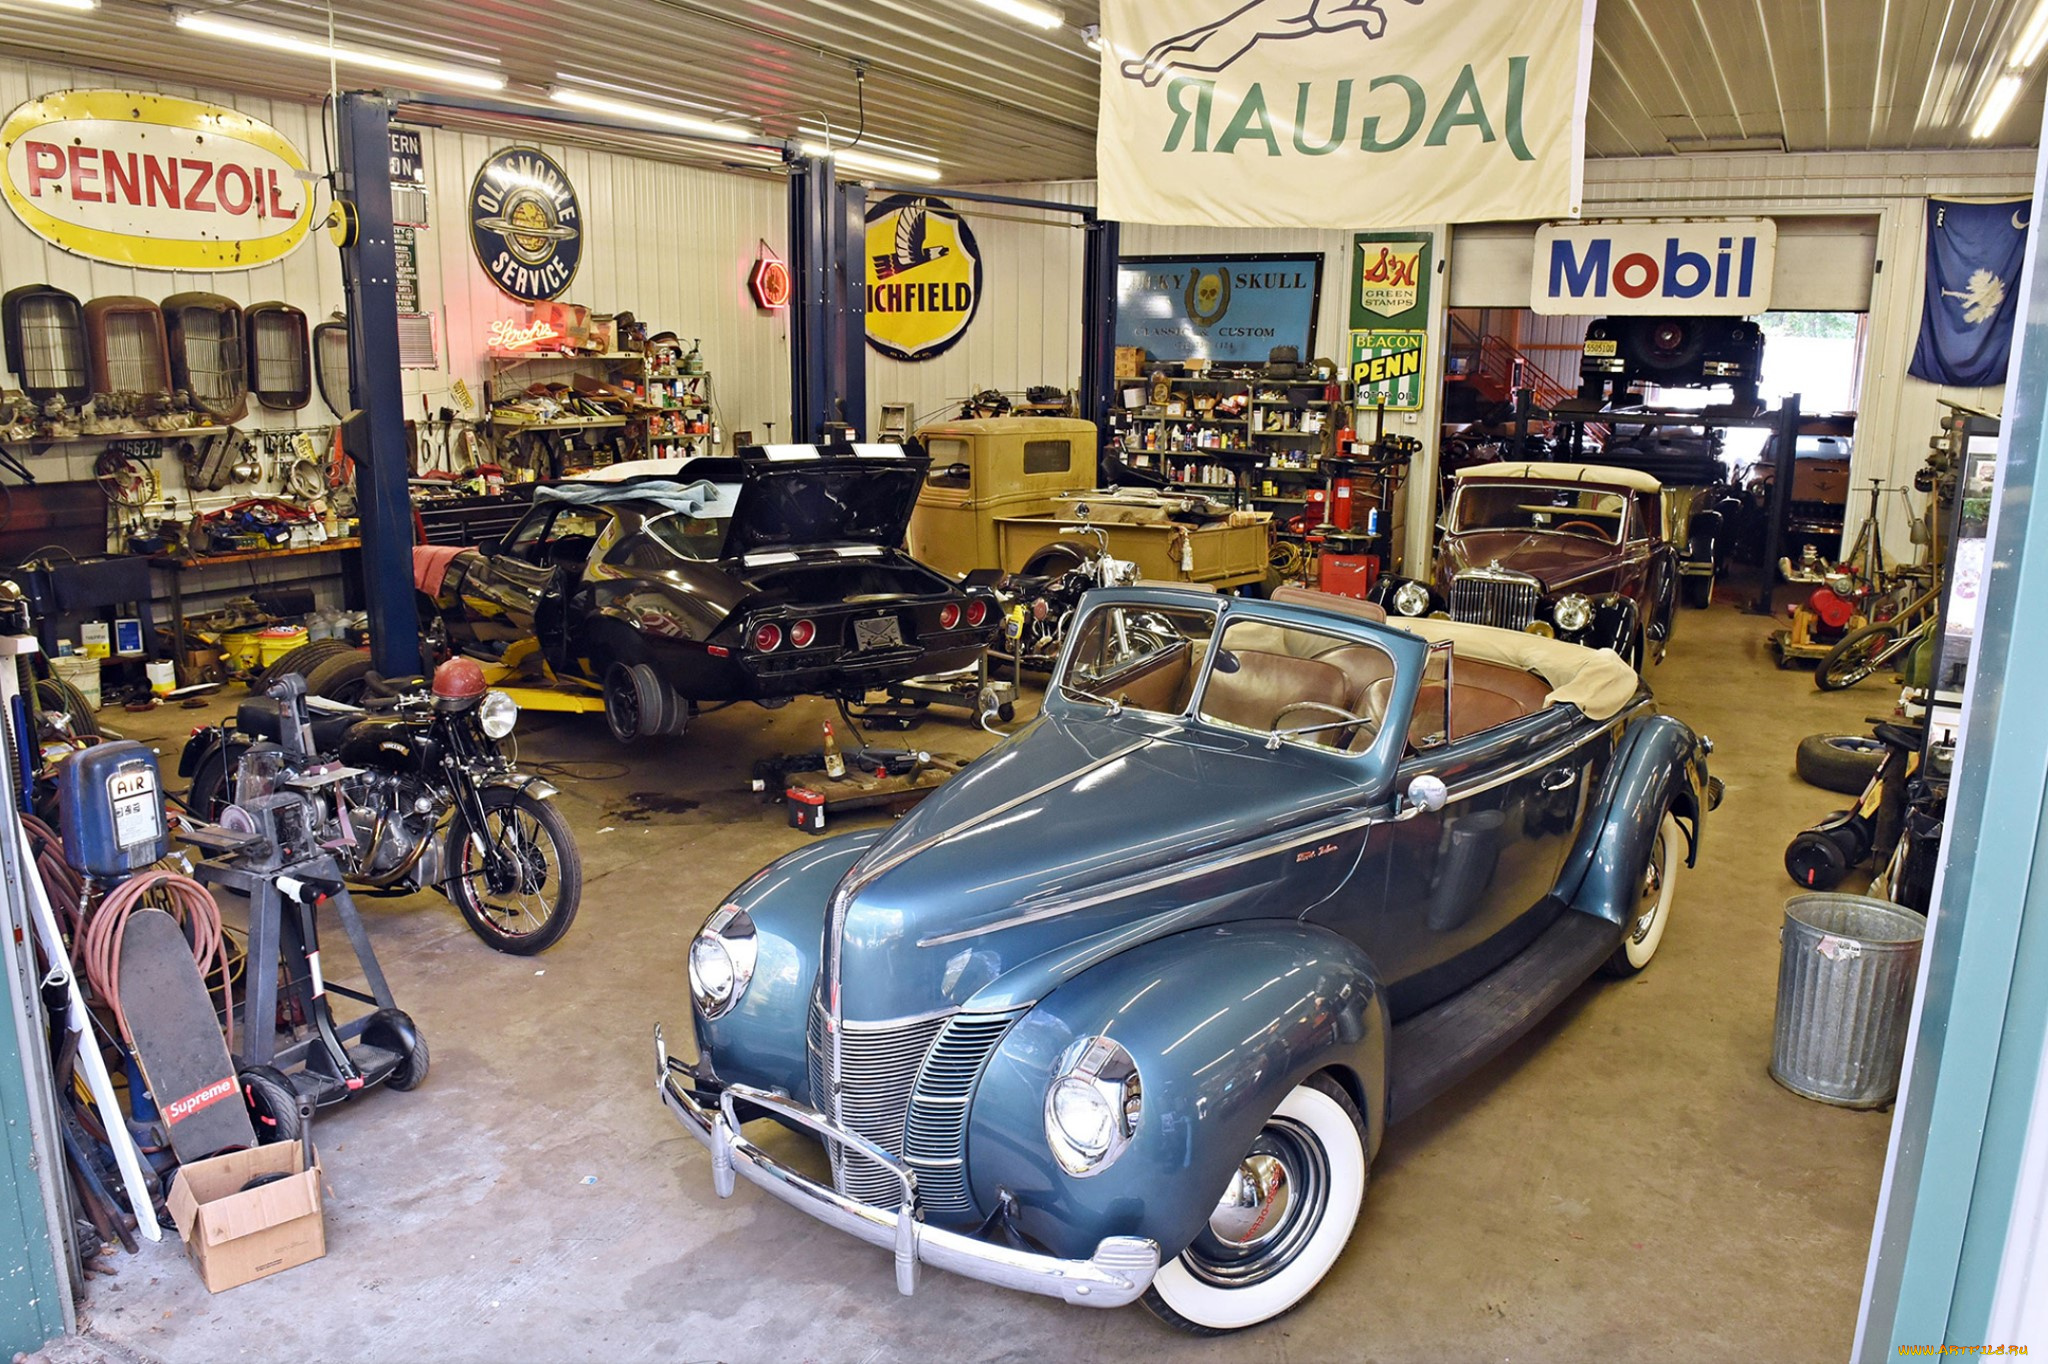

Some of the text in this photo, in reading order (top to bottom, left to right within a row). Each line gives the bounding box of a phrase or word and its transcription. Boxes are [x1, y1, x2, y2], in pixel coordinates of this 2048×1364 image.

[388, 134, 419, 154] ERN
[25, 140, 297, 219] PENNZOIL
[491, 251, 570, 296] SERVICE
[1548, 237, 1757, 299] Mobil
[1235, 273, 1307, 289] SKULL
[867, 282, 972, 313] ICHFIELD
[1365, 290, 1413, 298] GREEN
[1365, 299, 1413, 307] STAMPS
[1134, 327, 1190, 338] CLASSIC
[1218, 327, 1275, 338] CUSTOM
[1356, 336, 1420, 348] BEACON
[1353, 350, 1419, 384] PENN
[1356, 391, 1415, 401] MOTOR OIL
[117, 776, 145, 795] AIR
[170, 1081, 231, 1117] Supreme
